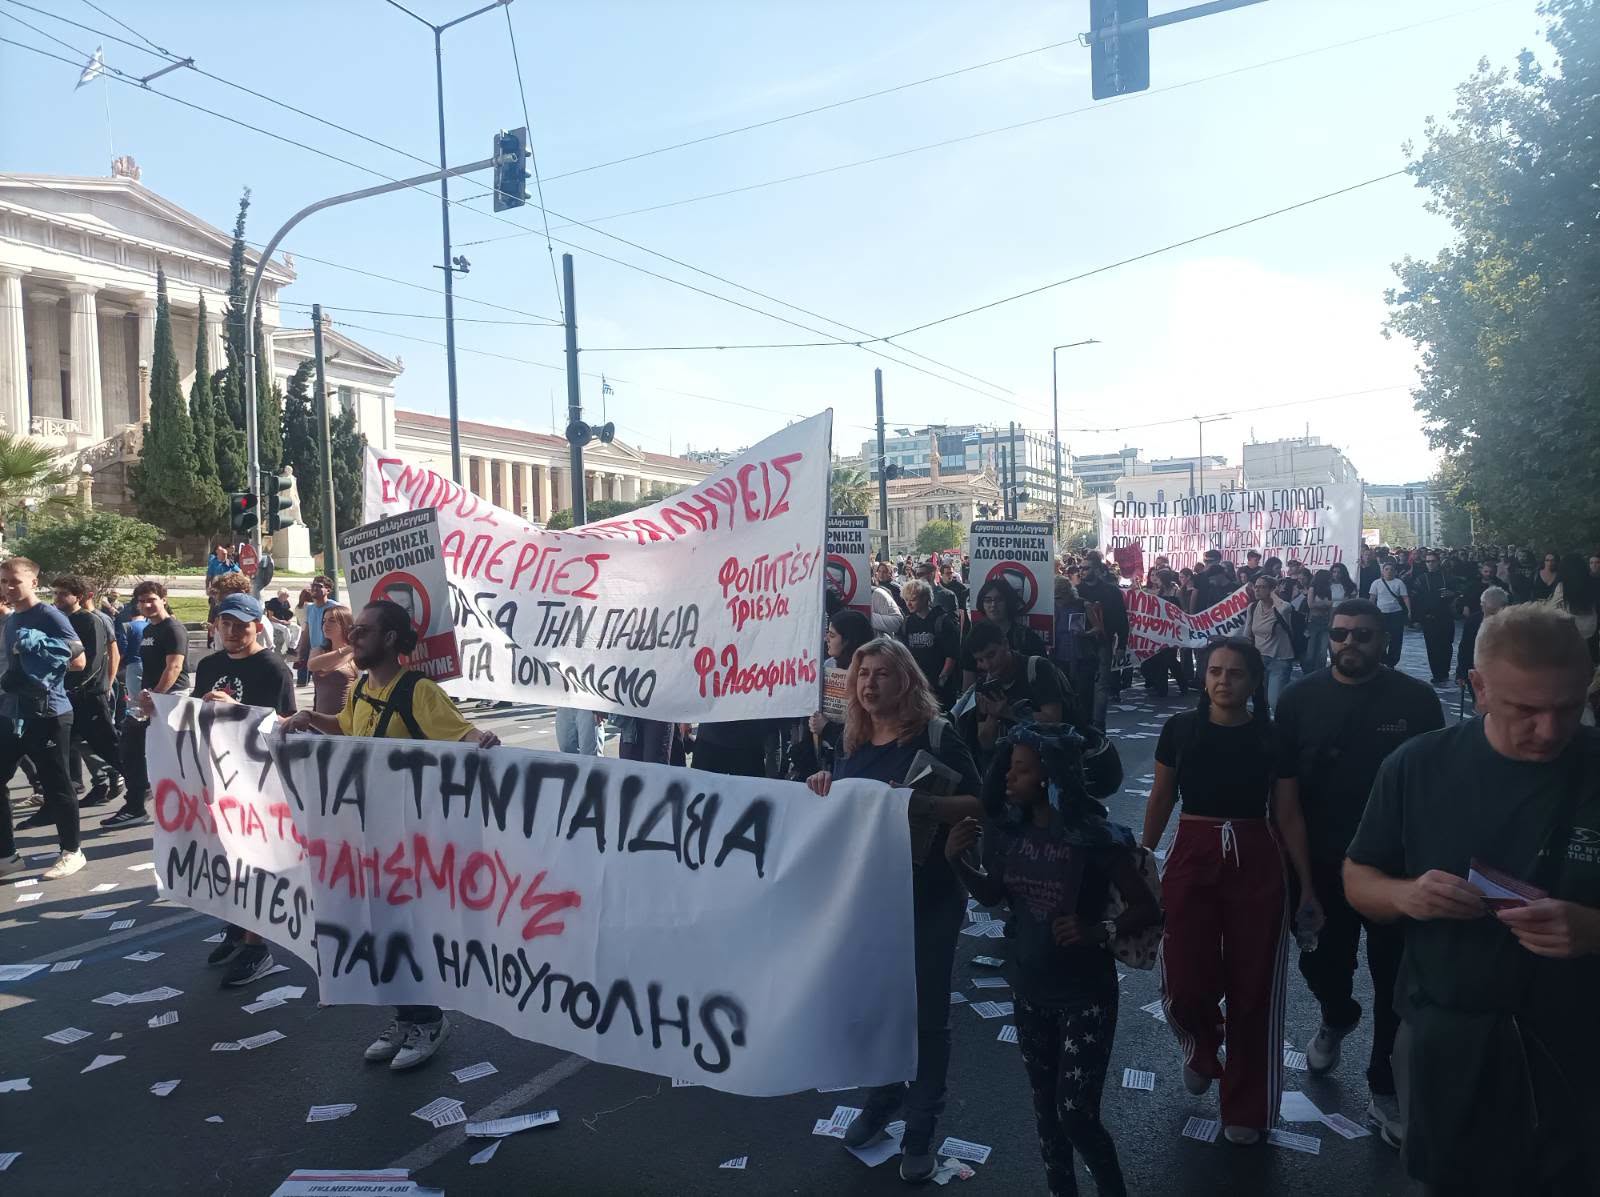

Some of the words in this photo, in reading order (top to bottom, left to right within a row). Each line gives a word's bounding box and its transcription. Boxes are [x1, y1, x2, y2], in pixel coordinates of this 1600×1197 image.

[1113, 499, 1146, 518] ΑΠΟ
[1149, 502, 1167, 517] ΤΗ
[1239, 490, 1265, 511] ΤΗΝ
[1152, 518, 1167, 535] ΤΟΥ
[1168, 515, 1201, 534] ΑΓΩΝΑ
[1204, 512, 1240, 533] ΠΕΡΑΣΕ
[1249, 511, 1263, 530] ΤΑ
[350, 528, 429, 567] ΚΥΒΕΡΝΗΣΗ
[827, 531, 862, 542] ΡΝΗΣΗ
[827, 543, 865, 555] ΦΟΝΩΝ
[974, 549, 1049, 562] ΔΟΛΟΦΟΝΩΝ
[977, 536, 1046, 549] ΚΥΒΕΡΝΗΣΗ
[1149, 535, 1164, 552] ΓΙΑ
[1167, 533, 1206, 552] ΔΗΜΟΣΙΑ
[1209, 531, 1222, 550] ΚΑΙ
[1225, 530, 1261, 549] ΔΩΡΕΑΝ
[1265, 526, 1325, 548] ΕΚΠΑΙΔΕΥΣΗ
[350, 545, 436, 584] ΔΟΛΟΦΟΝΩΝ
[440, 529, 609, 600] ΑΠΕΡΓΙΕΣ
[534, 599, 593, 649] ΤΗΝ
[599, 602, 701, 651] ΠΑΙΔΕΙΑ
[461, 638, 495, 683] ΓΙΑ
[155, 778, 218, 834] ΟΧΙ
[218, 796, 268, 842] ΓΙΑ
[388, 748, 519, 832] ΤΗΝ
[524, 760, 774, 878] ΠΑΙΔΕΙΑ
[311, 921, 424, 987] ΠΑΛ
[433, 932, 747, 1073] ΗΛΙΟΥΠΟΛΗΣ
